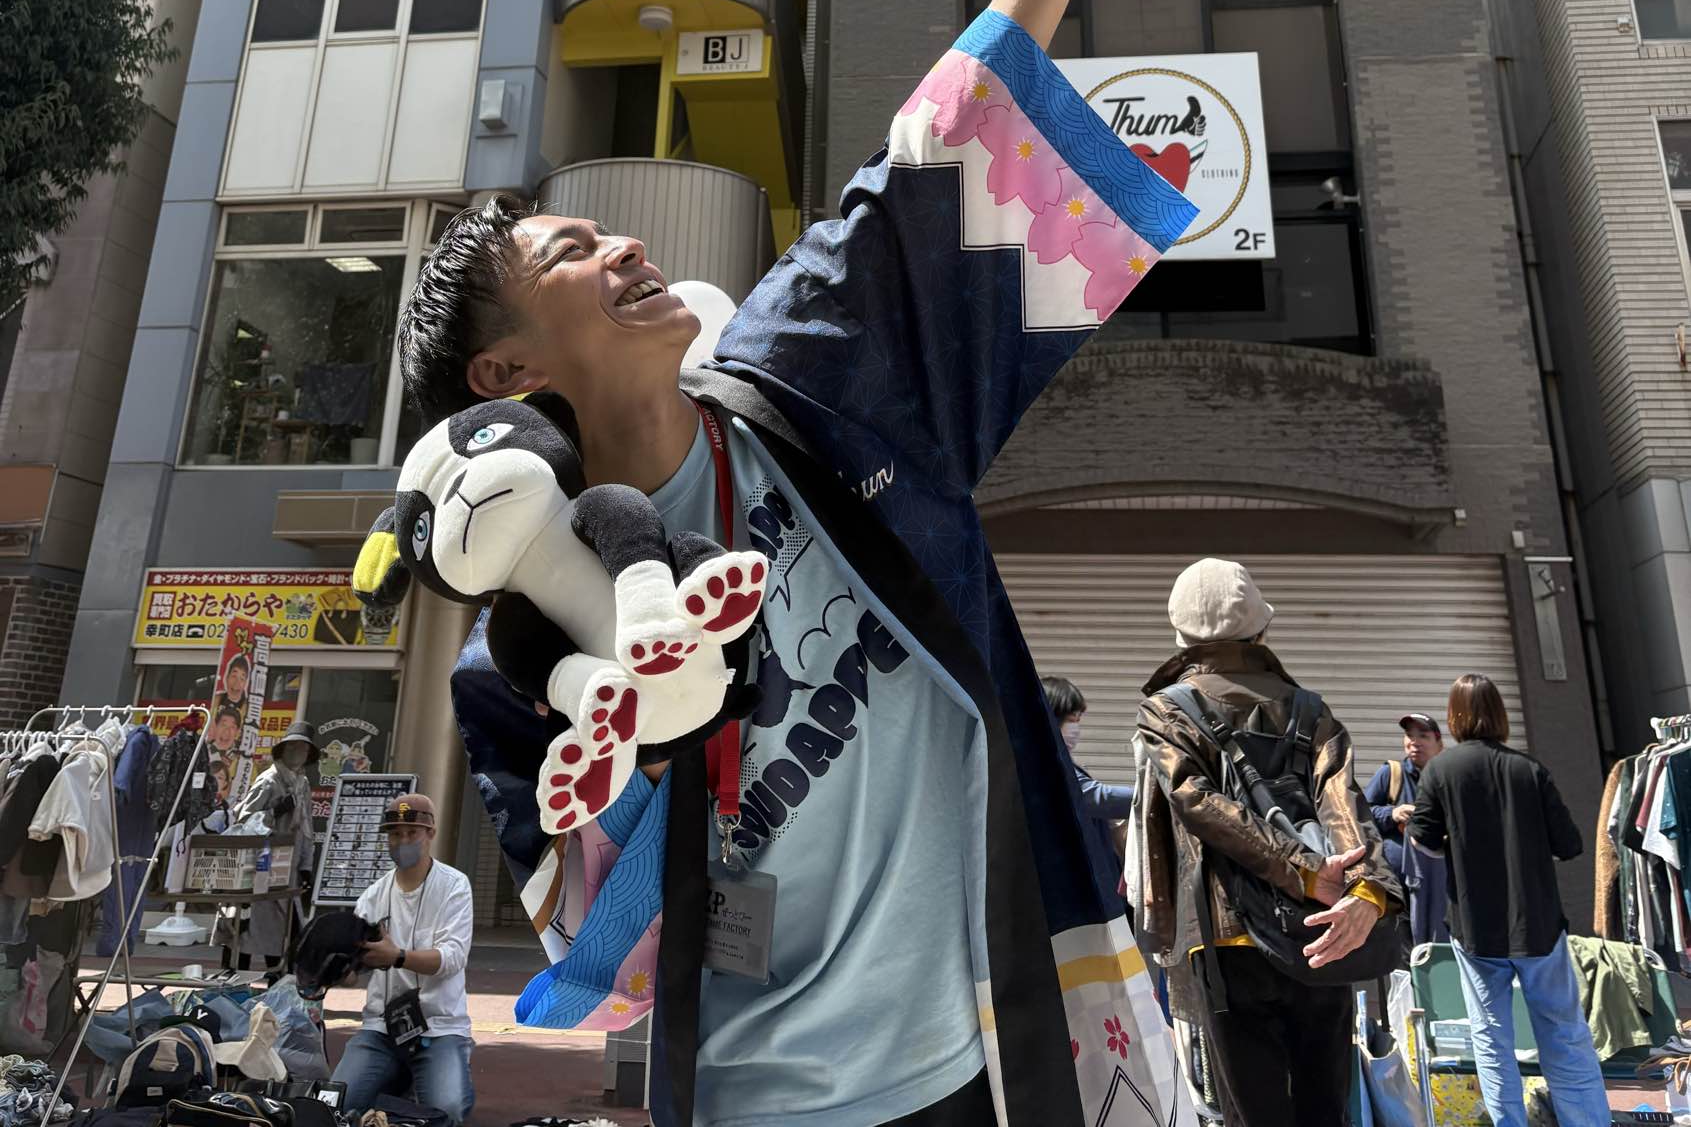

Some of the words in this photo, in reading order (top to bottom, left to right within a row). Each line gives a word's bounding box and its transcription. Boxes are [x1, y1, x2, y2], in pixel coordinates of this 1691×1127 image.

[707, 37, 743, 62] BJ
[1234, 229, 1266, 251] 2F
[176, 592, 283, 618] おたからや
